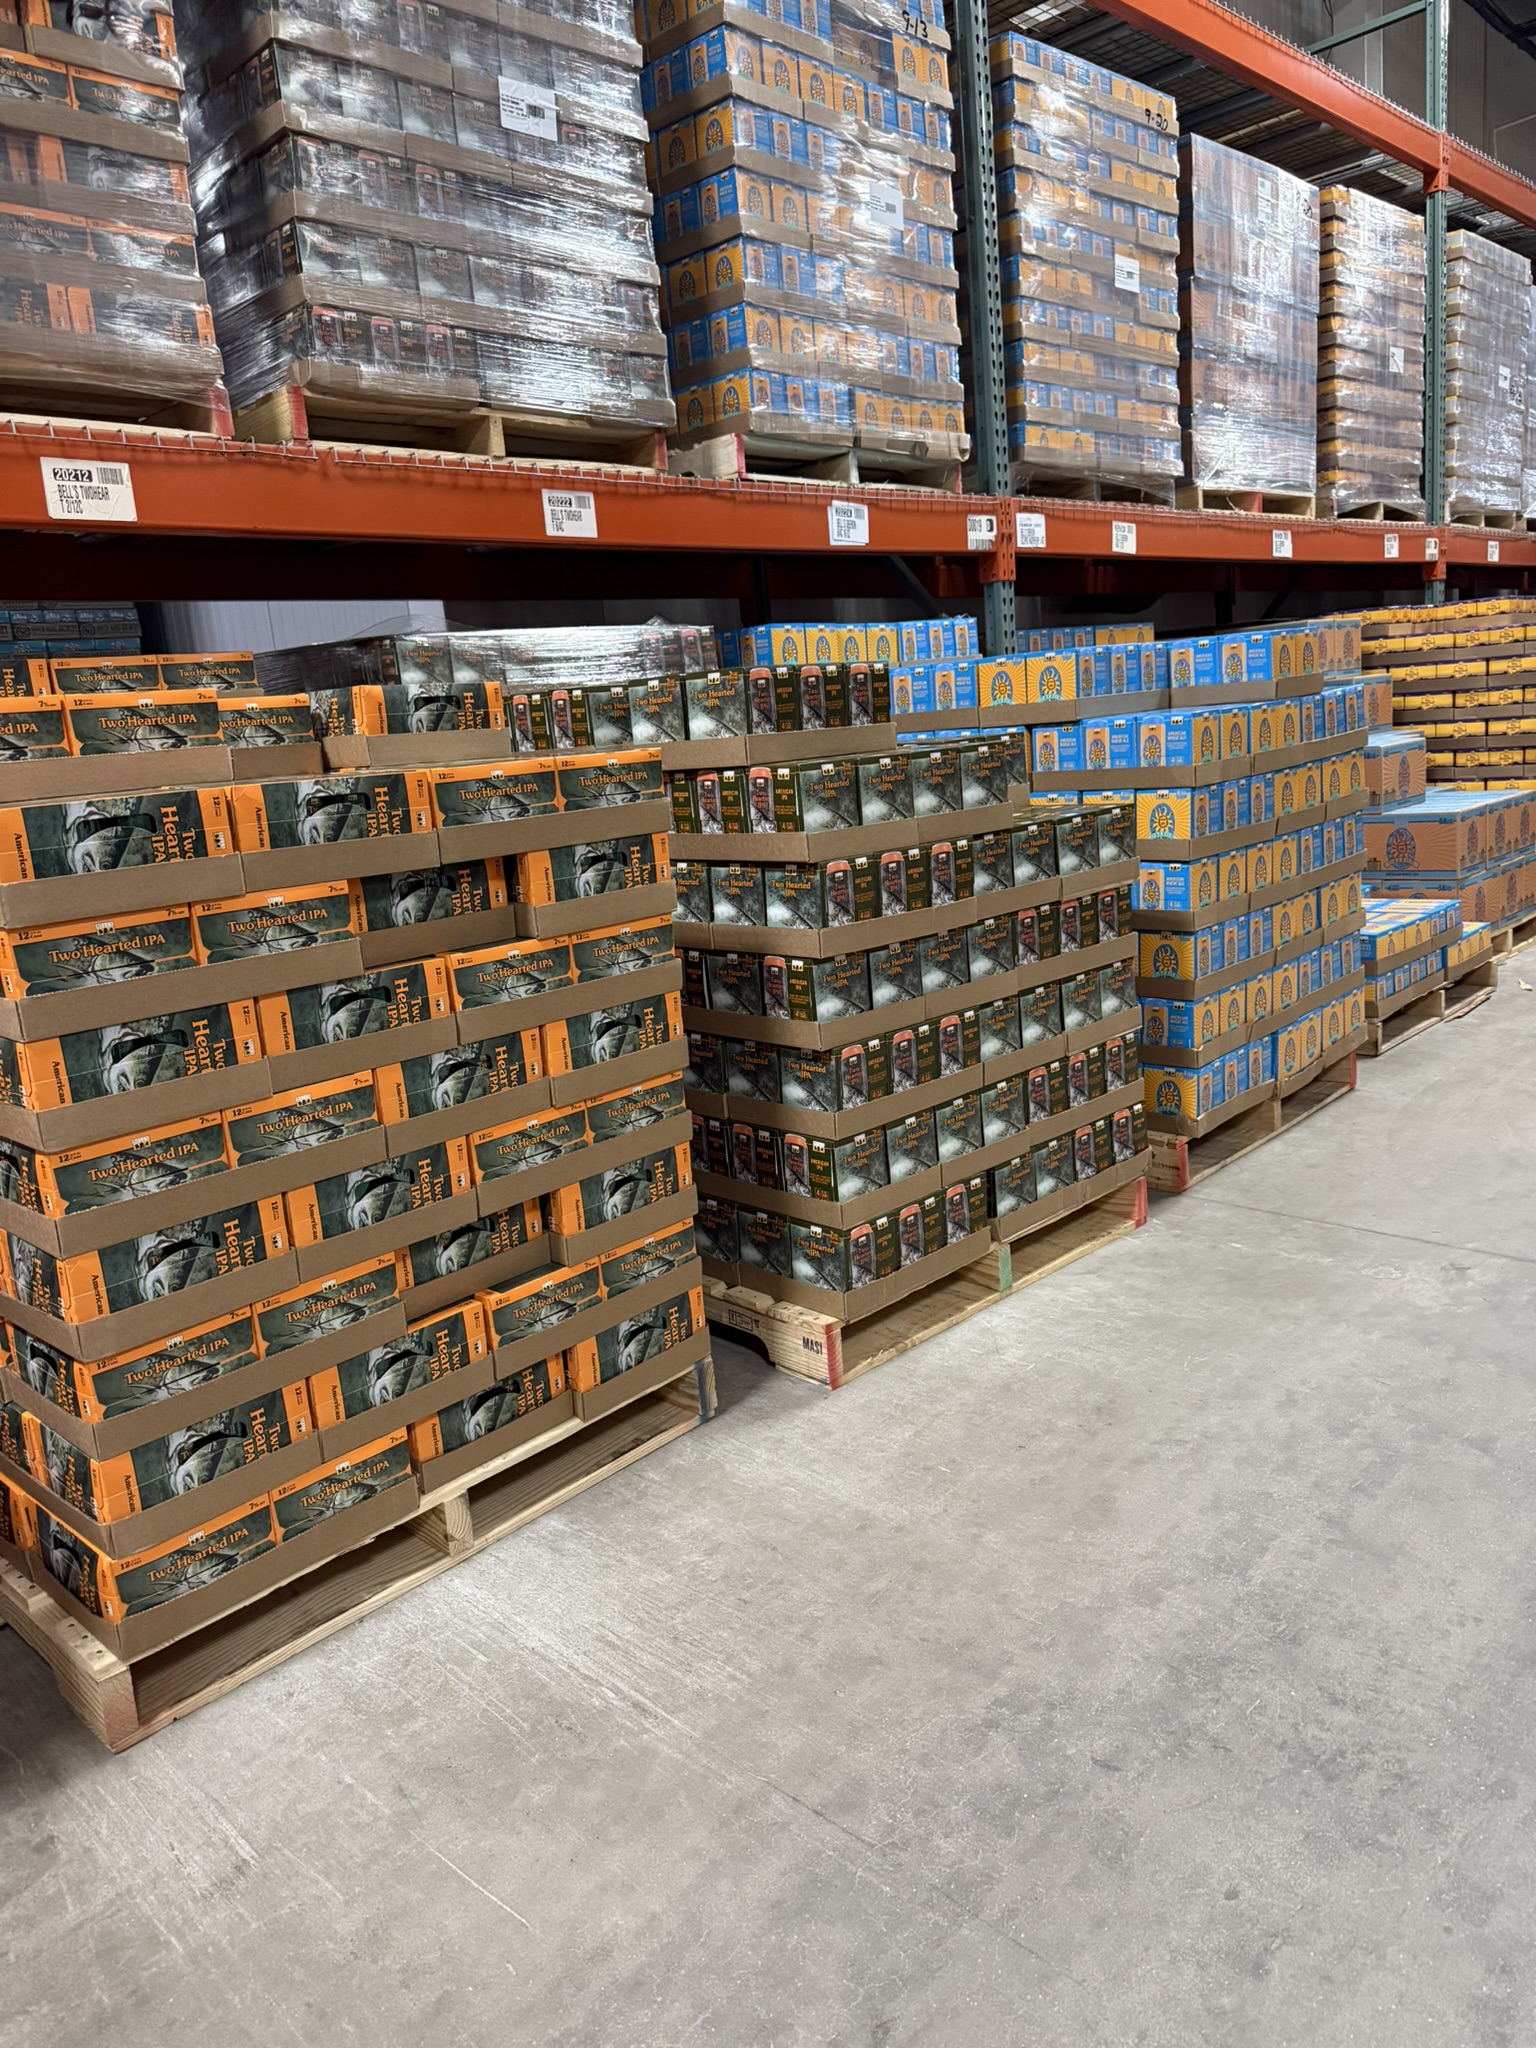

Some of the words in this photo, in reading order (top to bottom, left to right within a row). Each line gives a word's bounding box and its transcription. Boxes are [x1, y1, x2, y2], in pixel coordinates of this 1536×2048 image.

[54, 468, 90, 482] 20212
[58, 484, 79, 500] BELL'S
[75, 674, 94, 682] Two
[94, 672, 128, 681] Hearted
[129, 671, 144, 680] IPA
[16, 723, 38, 734] IPA
[99, 717, 125, 728] Two
[127, 714, 176, 726] Hearted
[178, 714, 198, 724] IPA
[232, 717, 276, 727] Hearted
[278, 716, 294, 724] IPA
[459, 790, 481, 800] Two
[482, 785, 522, 798] Hearted
[524, 784, 538, 793] IPA
[579, 776, 598, 786] Two
[600, 773, 633, 784] Hearted
[635, 771, 648, 780] IPA
[254, 806, 266, 848] American
[367, 813, 378, 838] IPA
[13, 832, 28, 880] American
[151, 836, 166, 863] IPA
[227, 921, 255, 934] Two
[256, 912, 308, 929] Hearted
[309, 908, 328, 920] IPA
[353, 894, 365, 932] American
[48, 948, 81, 964] Two
[82, 936, 141, 958] Hearted
[142, 934, 166, 947] IPA
[592, 946, 611, 957] Two
[612, 939, 645, 953] Hearted
[646, 936, 660, 946] IPA
[476, 972, 498, 984] Two
[498, 962, 536, 978] Hearted
[538, 958, 554, 969] IPA
[280, 1011, 290, 1051] American
[386, 1005, 400, 1028] IPA
[184, 1048, 198, 1076] IPA
[560, 1036, 570, 1070] American
[52, 1060, 66, 1104] American
[394, 1082, 405, 1118] American
[256, 1120, 284, 1135] Two
[284, 1107, 333, 1128] Hearted
[335, 1101, 354, 1114] IPA
[88, 1166, 118, 1182] Two
[118, 1150, 176, 1174] Hearted
[178, 1142, 200, 1158] IPA
[410, 1186, 422, 1208] IPA
[308, 1203, 318, 1240] American
[574, 1198, 582, 1230] American
[216, 1250, 228, 1276] IPA
[401, 1253, 410, 1288] American
[620, 1258, 637, 1272] Two
[636, 1246, 668, 1265] Hearted
[669, 1240, 682, 1252] IPA
[91, 1274, 104, 1315] American
[285, 1308, 310, 1324] Two
[310, 1290, 358, 1314] Hearted
[360, 1282, 377, 1294] IPA
[514, 1306, 534, 1320] Two
[532, 1290, 570, 1312] Hearted
[570, 1282, 584, 1295] IPA
[802, 1336, 822, 1356] MASI
[124, 1368, 154, 1386] Two
[154, 1346, 207, 1374] Hearted
[209, 1338, 230, 1353] IPA
[428, 1356, 441, 1380] IPA
[590, 1352, 598, 1383] American
[331, 1384, 341, 1421] American
[242, 1438, 255, 1464] IPA
[430, 1422, 440, 1456] American
[123, 1474, 136, 1513] American
[301, 1490, 325, 1508] Two
[325, 1468, 372, 1498] Hearted
[373, 1460, 390, 1474] IPA
[146, 1564, 176, 1583] Two
[176, 1538, 228, 1568] Hearted
[229, 1527, 249, 1543] IPA
